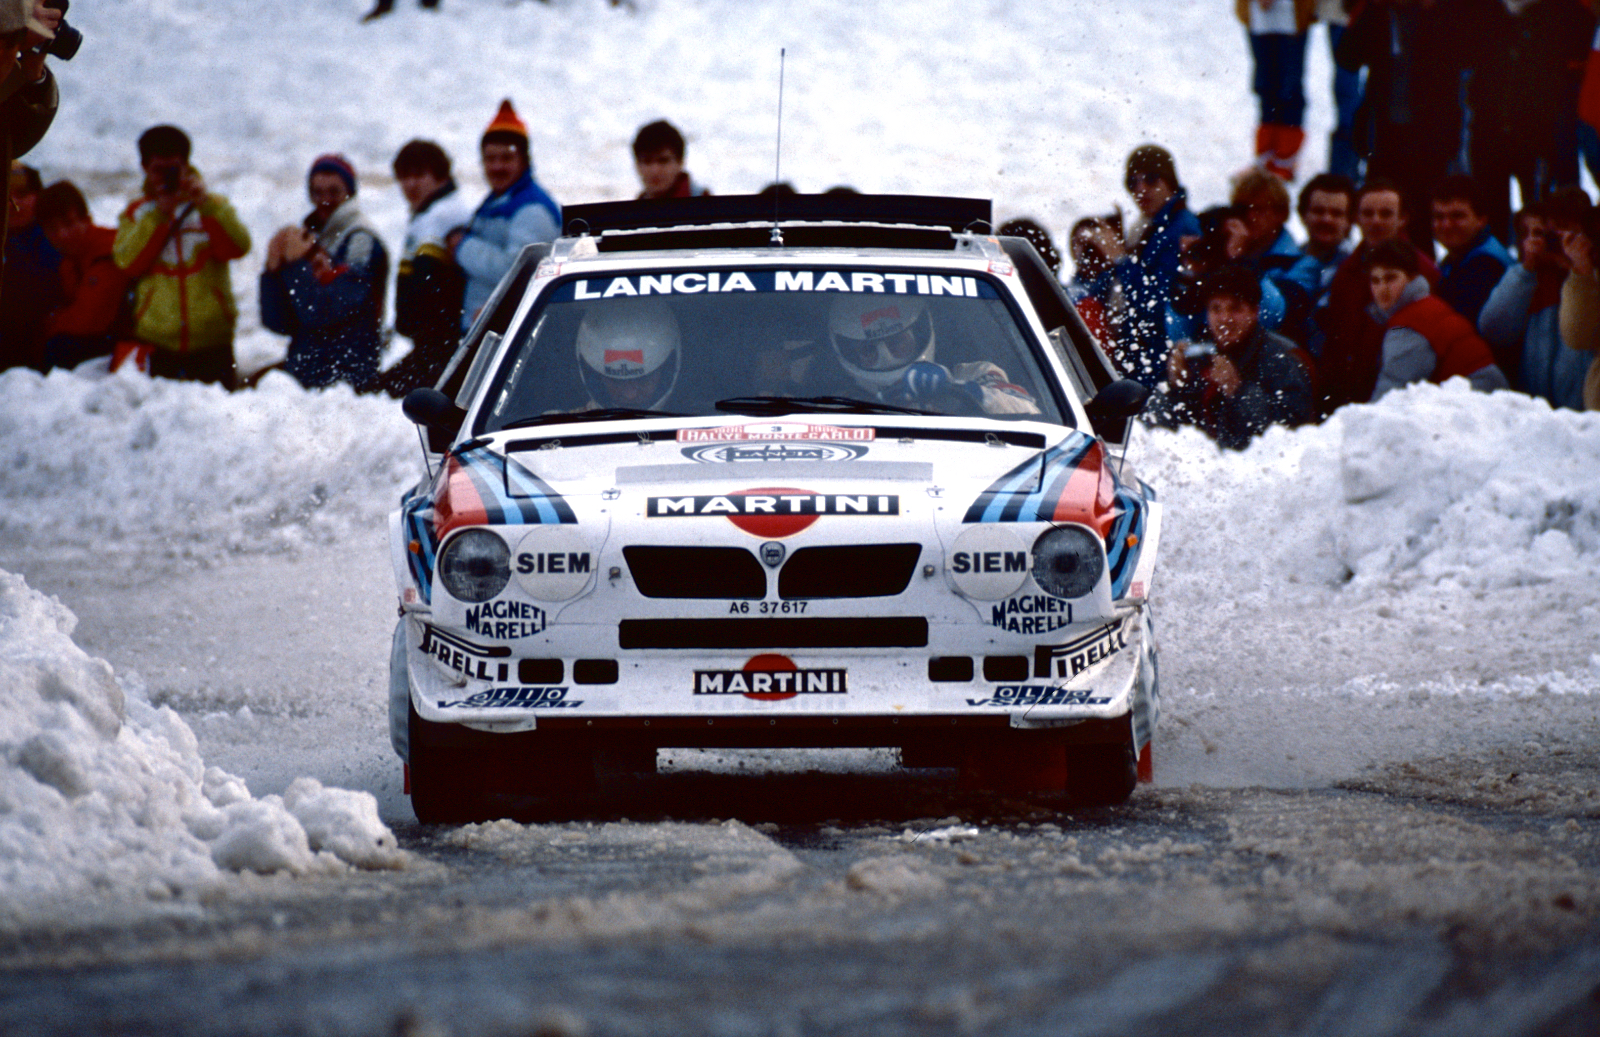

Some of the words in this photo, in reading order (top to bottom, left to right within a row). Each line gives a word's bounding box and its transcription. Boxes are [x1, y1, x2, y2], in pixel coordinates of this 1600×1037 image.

[574, 272, 756, 300] LANCIA
[774, 271, 979, 298] MARTINI
[687, 429, 743, 441] RALLYE
[734, 450, 819, 458] LANCIA
[657, 496, 889, 514] MARTINI
[516, 552, 591, 574] SIEM
[952, 551, 1026, 573] SIEM
[466, 600, 546, 622] MAGNETI
[729, 601, 750, 614] A6
[992, 596, 1072, 617] MAGNETI
[466, 618, 546, 639] MARELLI
[992, 614, 1072, 635] MARELLI
[418, 622, 511, 682] PIRELLI
[700, 672, 840, 693] MARTINI
[997, 686, 1089, 698] OLIO
[471, 688, 565, 700] OLIO
